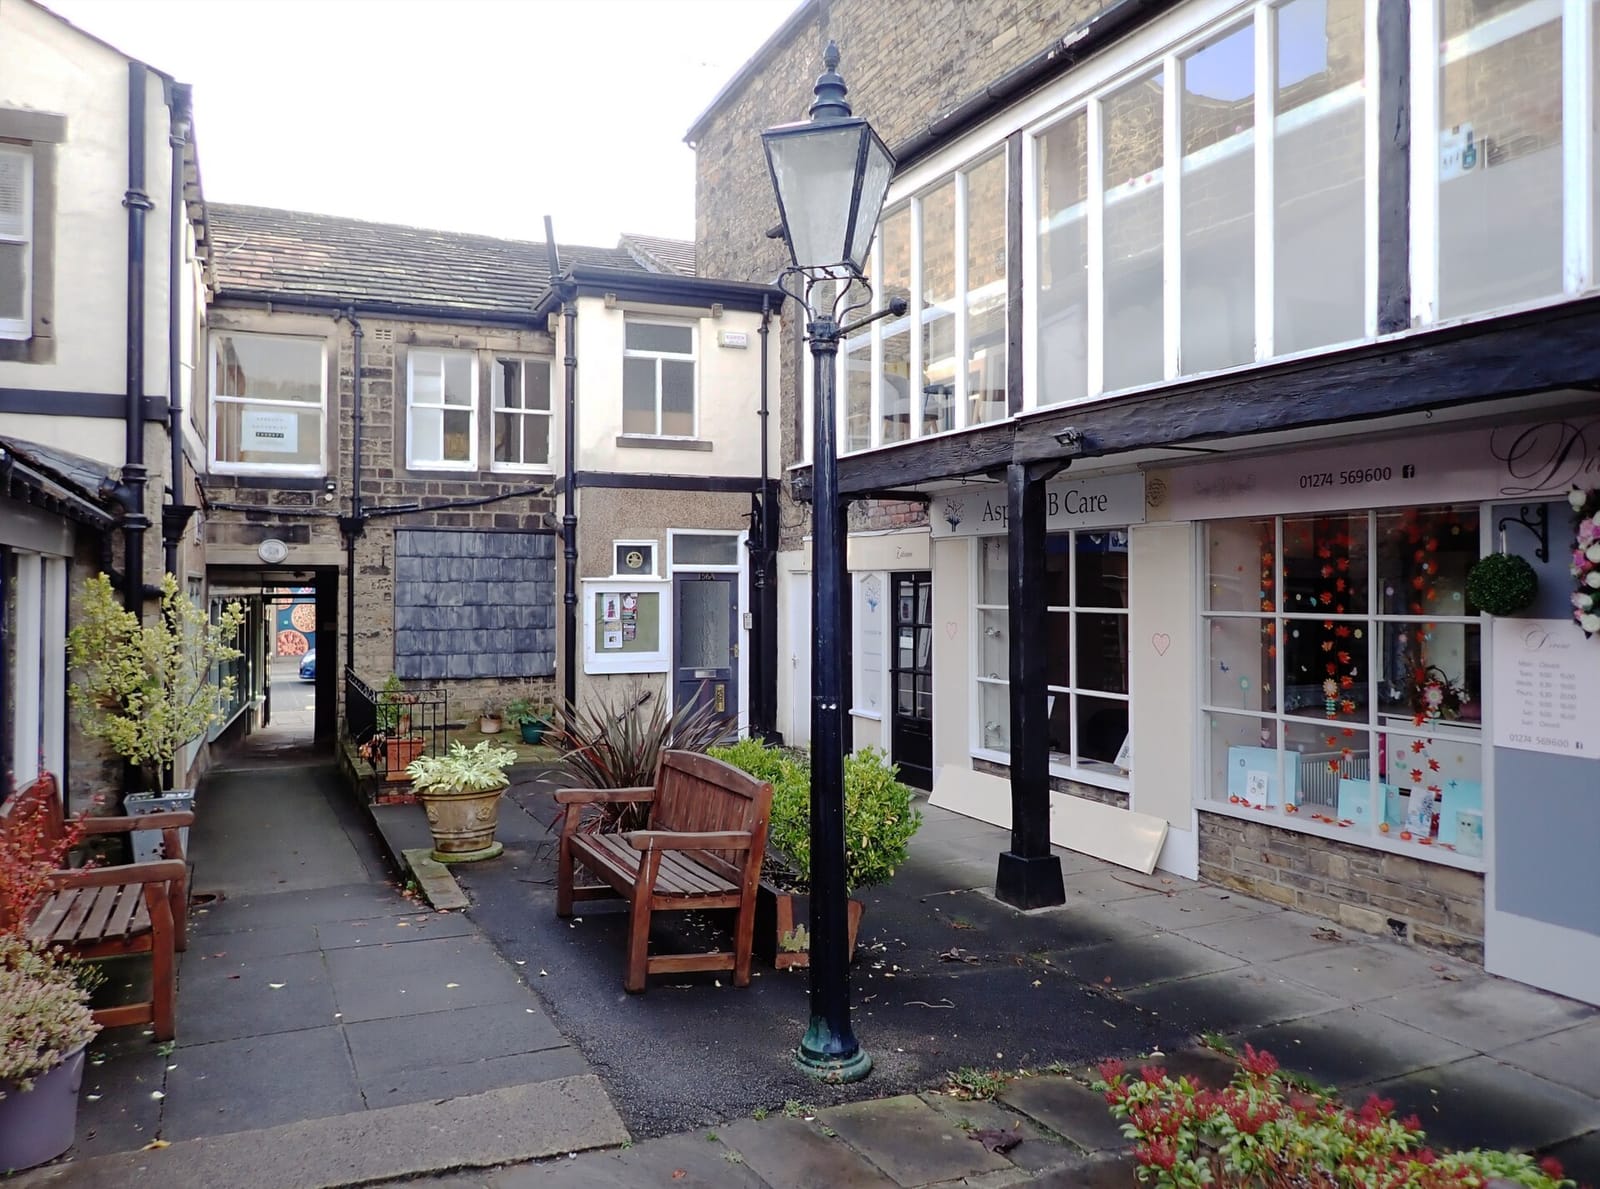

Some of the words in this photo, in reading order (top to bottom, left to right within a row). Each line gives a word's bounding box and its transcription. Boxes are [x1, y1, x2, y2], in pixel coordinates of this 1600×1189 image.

[1299, 473, 1333, 488] 01274
[1340, 466, 1392, 485] 569600
[982, 499, 1009, 528] Asp
[1064, 489, 1108, 515] Care
[1509, 734, 1532, 743] 01274
